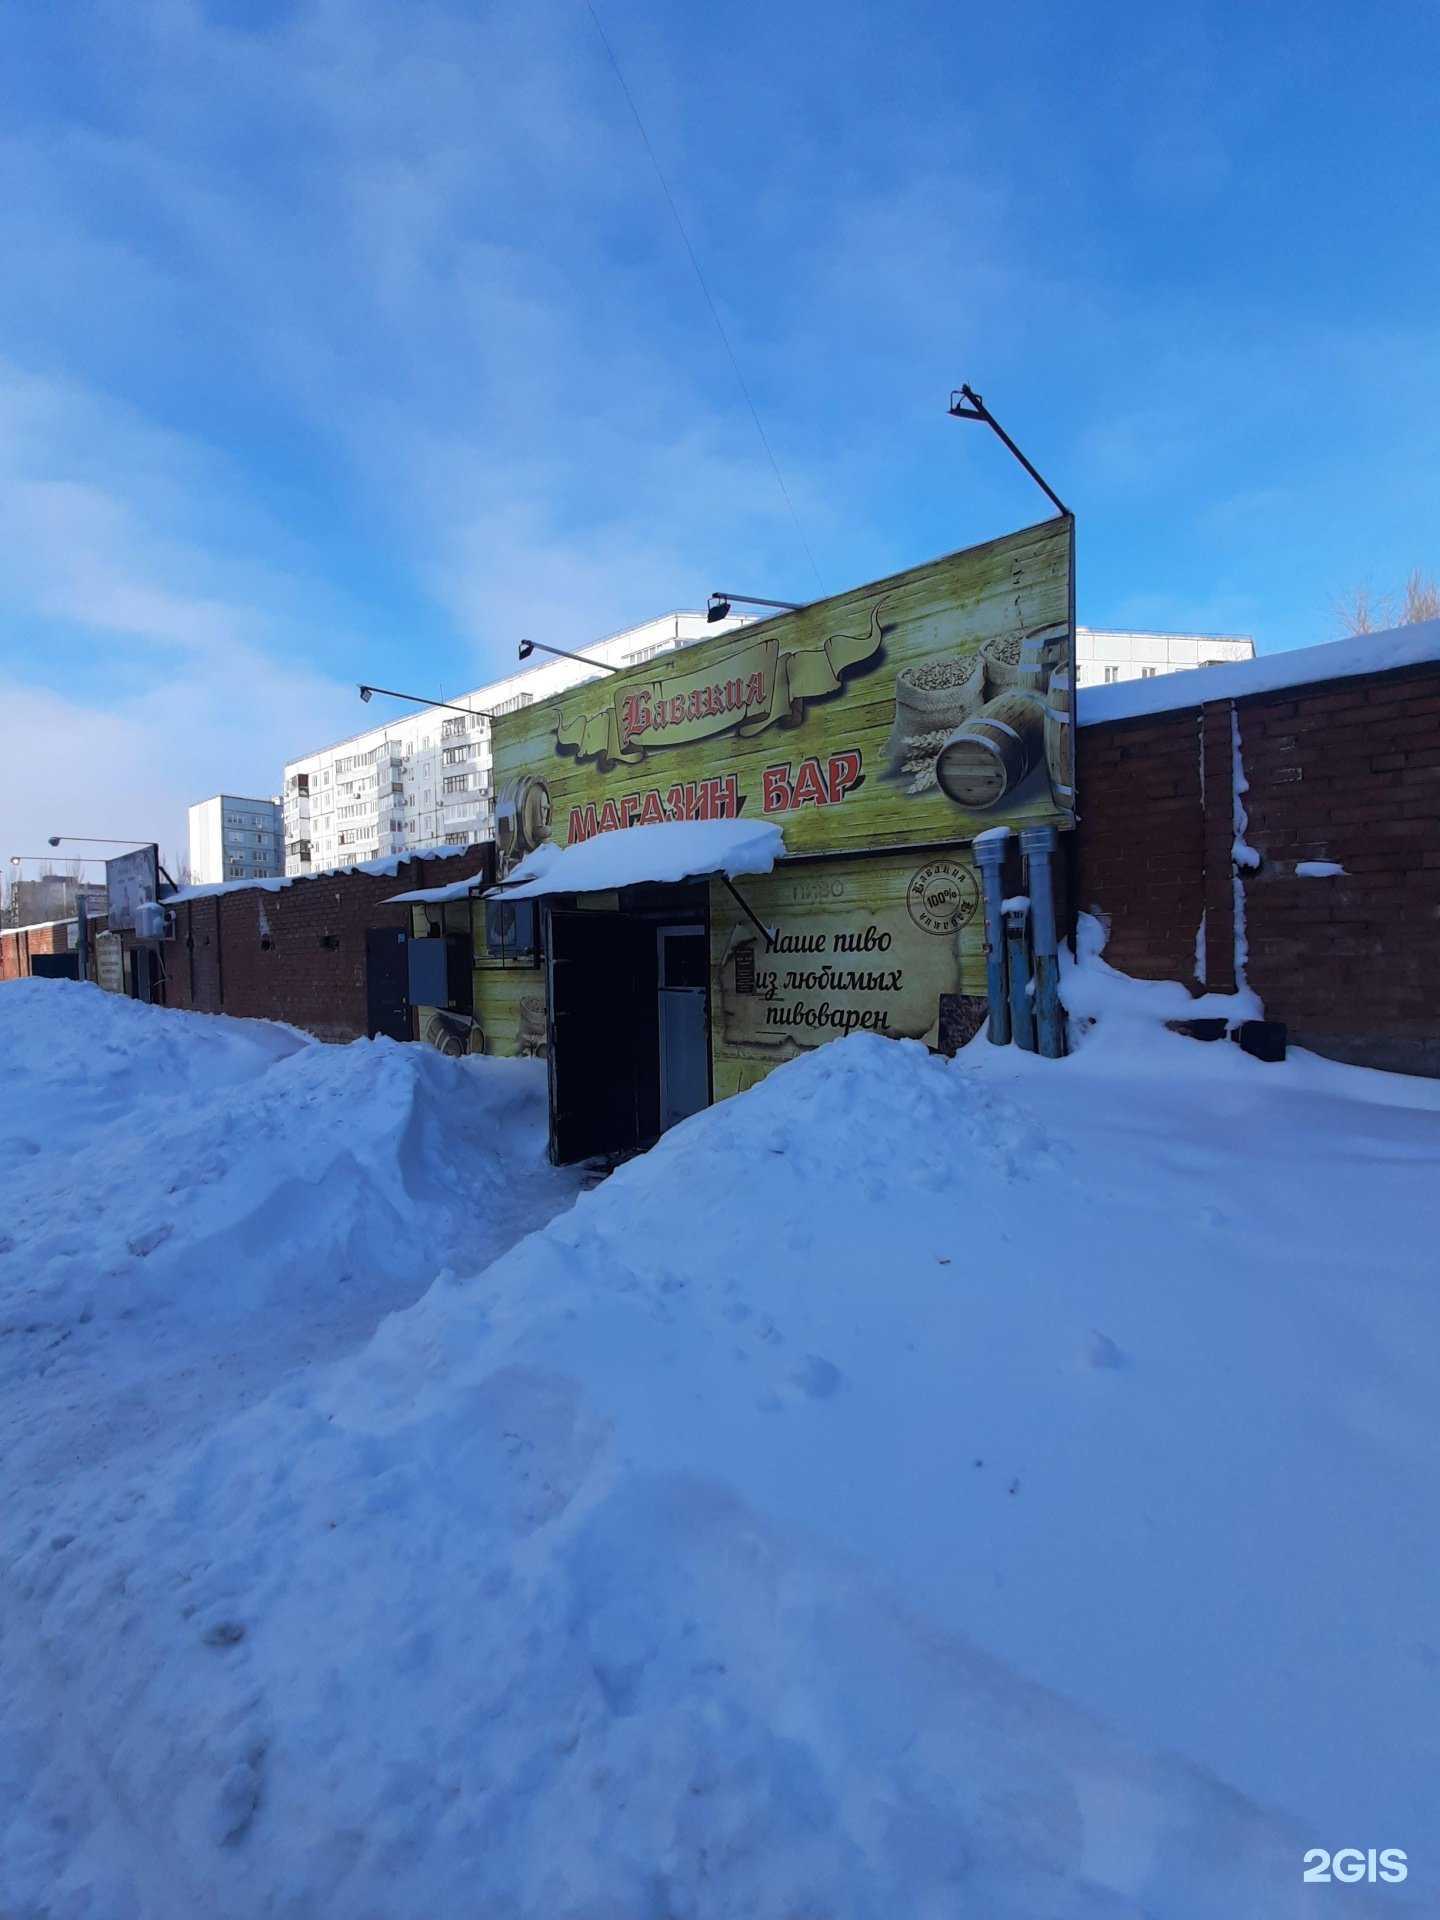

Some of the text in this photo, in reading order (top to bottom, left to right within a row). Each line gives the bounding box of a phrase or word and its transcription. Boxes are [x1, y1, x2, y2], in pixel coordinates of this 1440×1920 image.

[566, 749, 866, 844] МАГАЗИН БАР
[926, 887, 959, 909] 100%
[765, 925, 892, 954] Наше пиво
[755, 965, 904, 1001] из любимых
[766, 1001, 891, 1037] пивоварен
